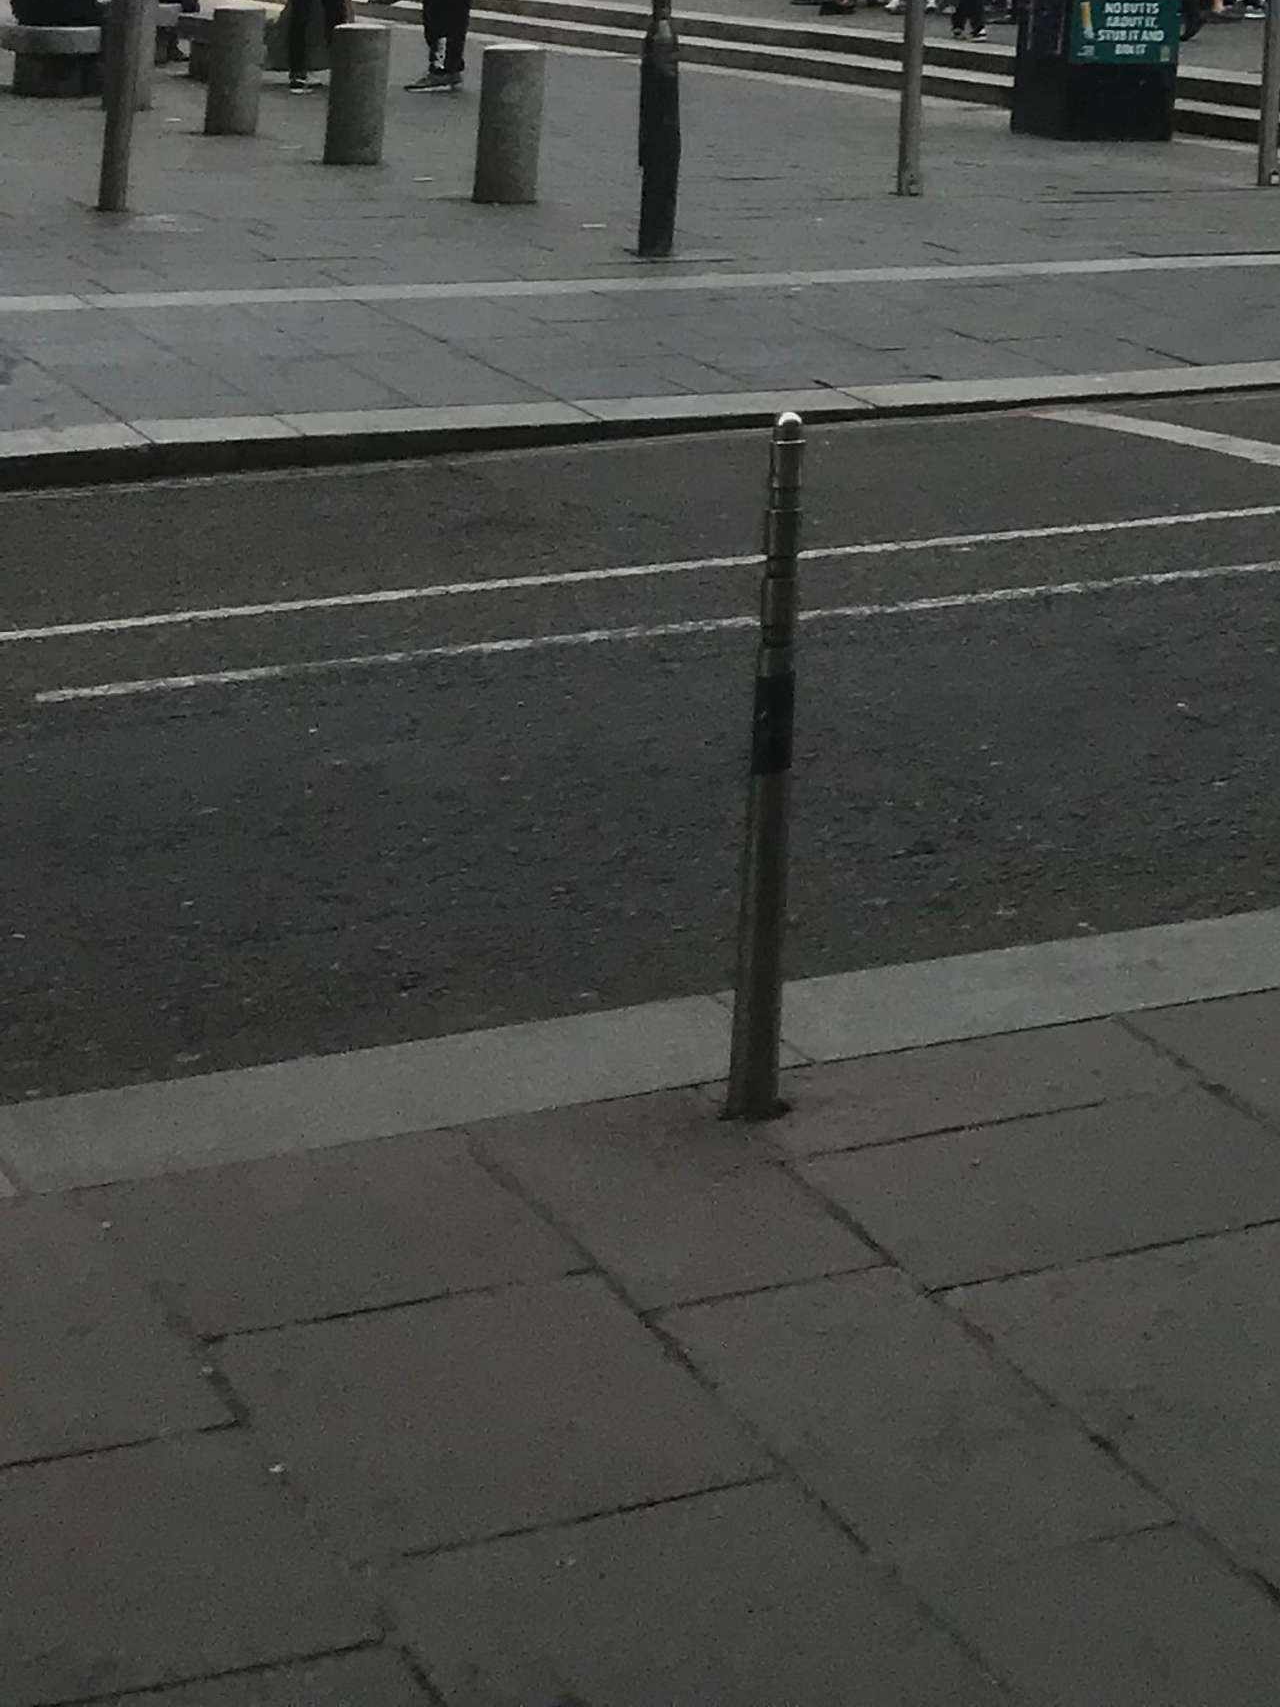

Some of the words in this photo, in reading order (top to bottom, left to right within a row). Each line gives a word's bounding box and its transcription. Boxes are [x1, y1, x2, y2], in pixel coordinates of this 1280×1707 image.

[1104, 2, 1121, 14] NO
[1122, 2, 1160, 14] BUTTS
[1097, 29, 1127, 41] STUB
[1128, 30, 1140, 41] IT
[1140, 29, 1165, 42] AND
